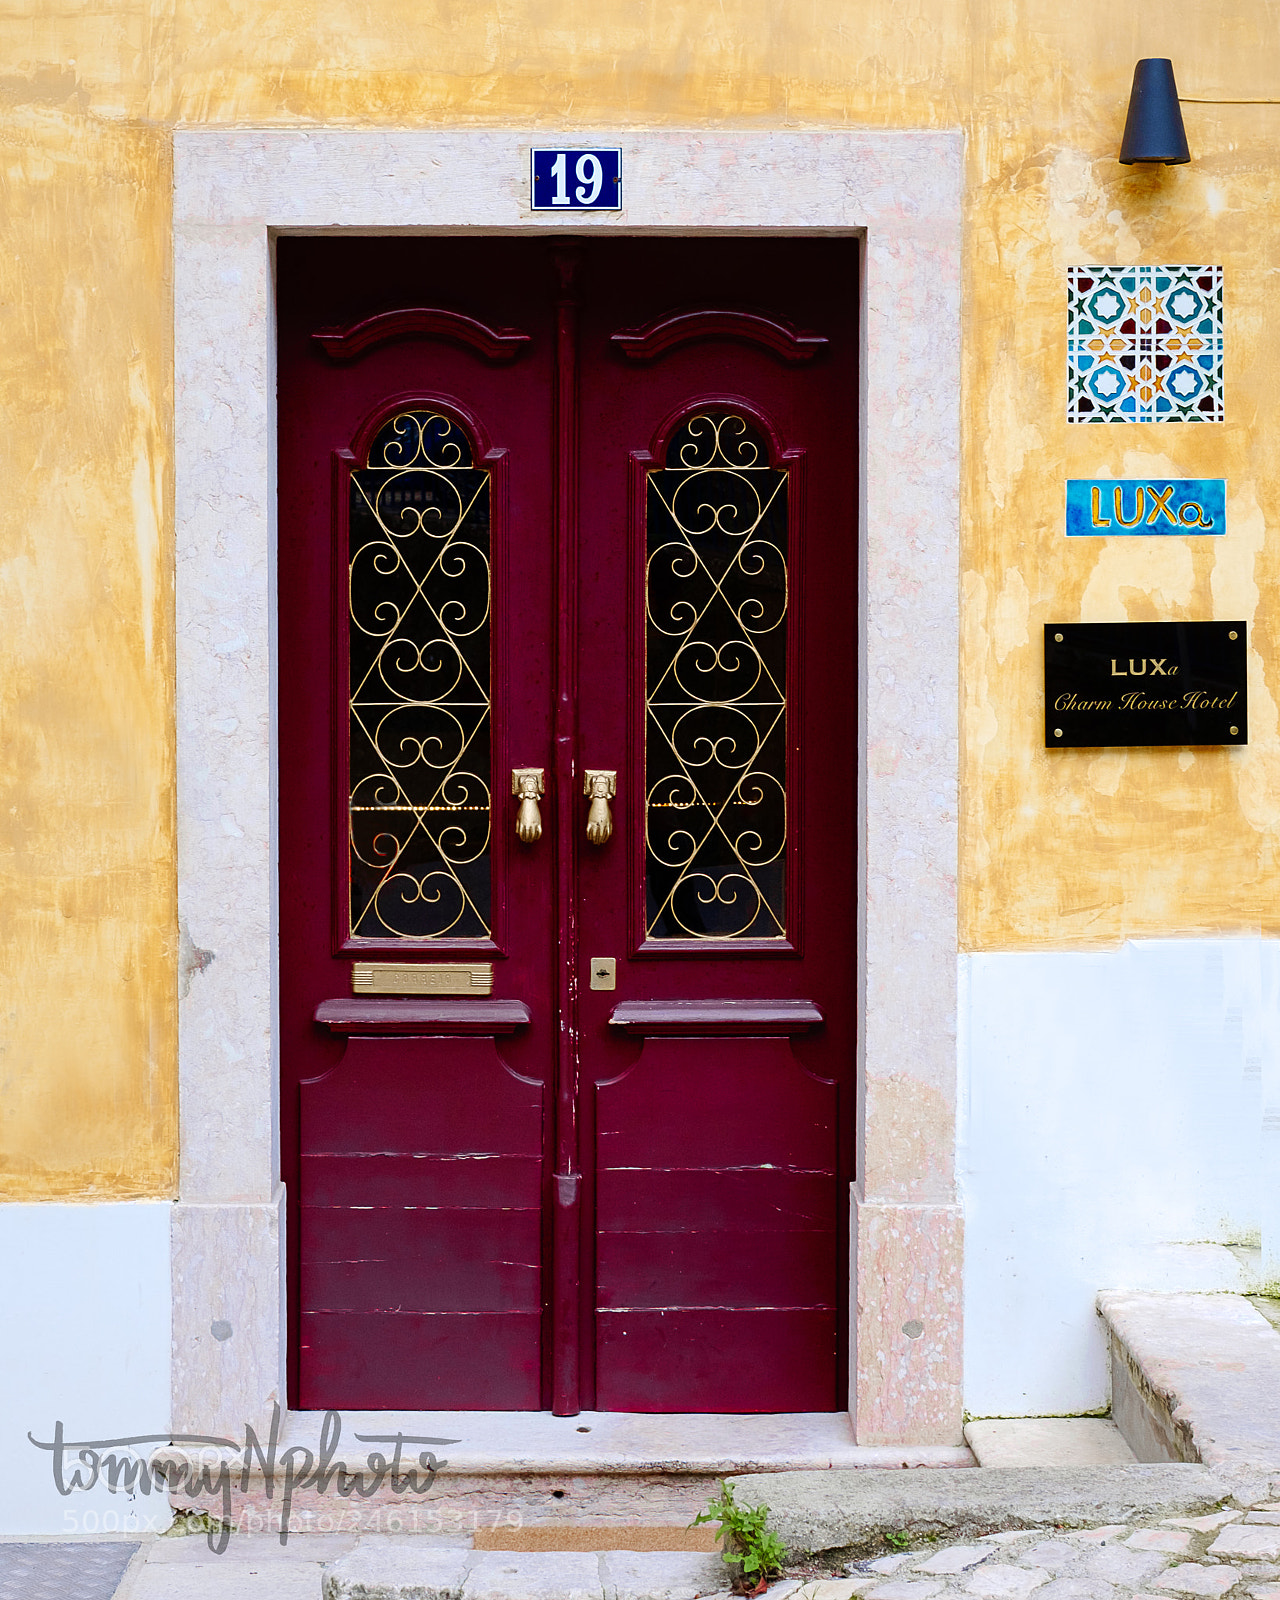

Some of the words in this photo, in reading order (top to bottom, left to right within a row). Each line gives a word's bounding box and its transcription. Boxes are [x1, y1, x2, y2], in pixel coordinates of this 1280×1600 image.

[551, 153, 603, 205] 19
[1091, 486, 1213, 528] LUXa
[1110, 658, 1179, 676] LUXa
[1054, 692, 1113, 711] Charm
[1118, 691, 1177, 710] House
[1179, 690, 1239, 709] Hotel
